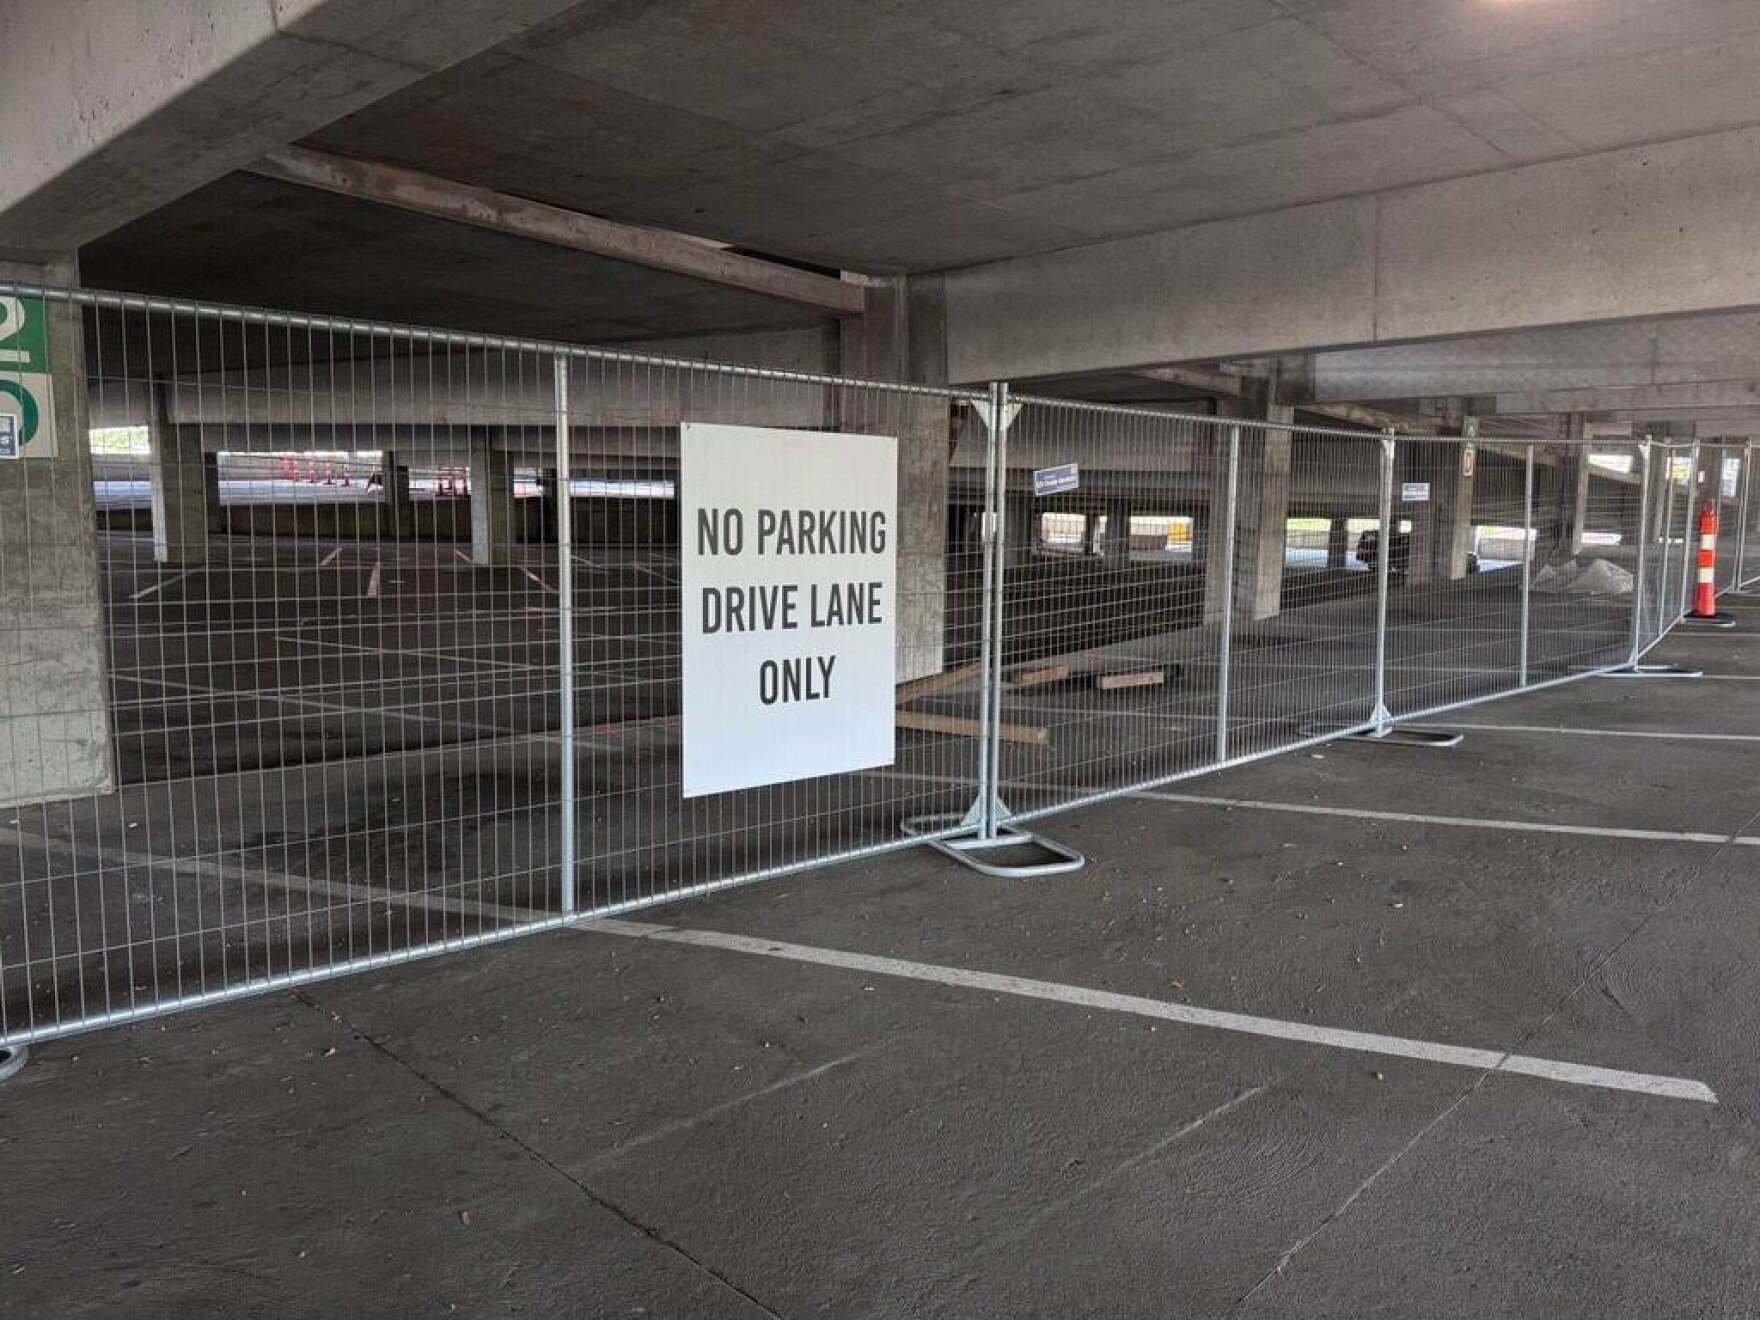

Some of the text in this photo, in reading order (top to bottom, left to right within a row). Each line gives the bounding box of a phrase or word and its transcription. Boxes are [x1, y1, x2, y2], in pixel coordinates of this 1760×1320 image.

[698, 508, 886, 556] NO PARKING
[703, 582, 883, 634] DRIVE LANE
[760, 655, 836, 706] ONLY
